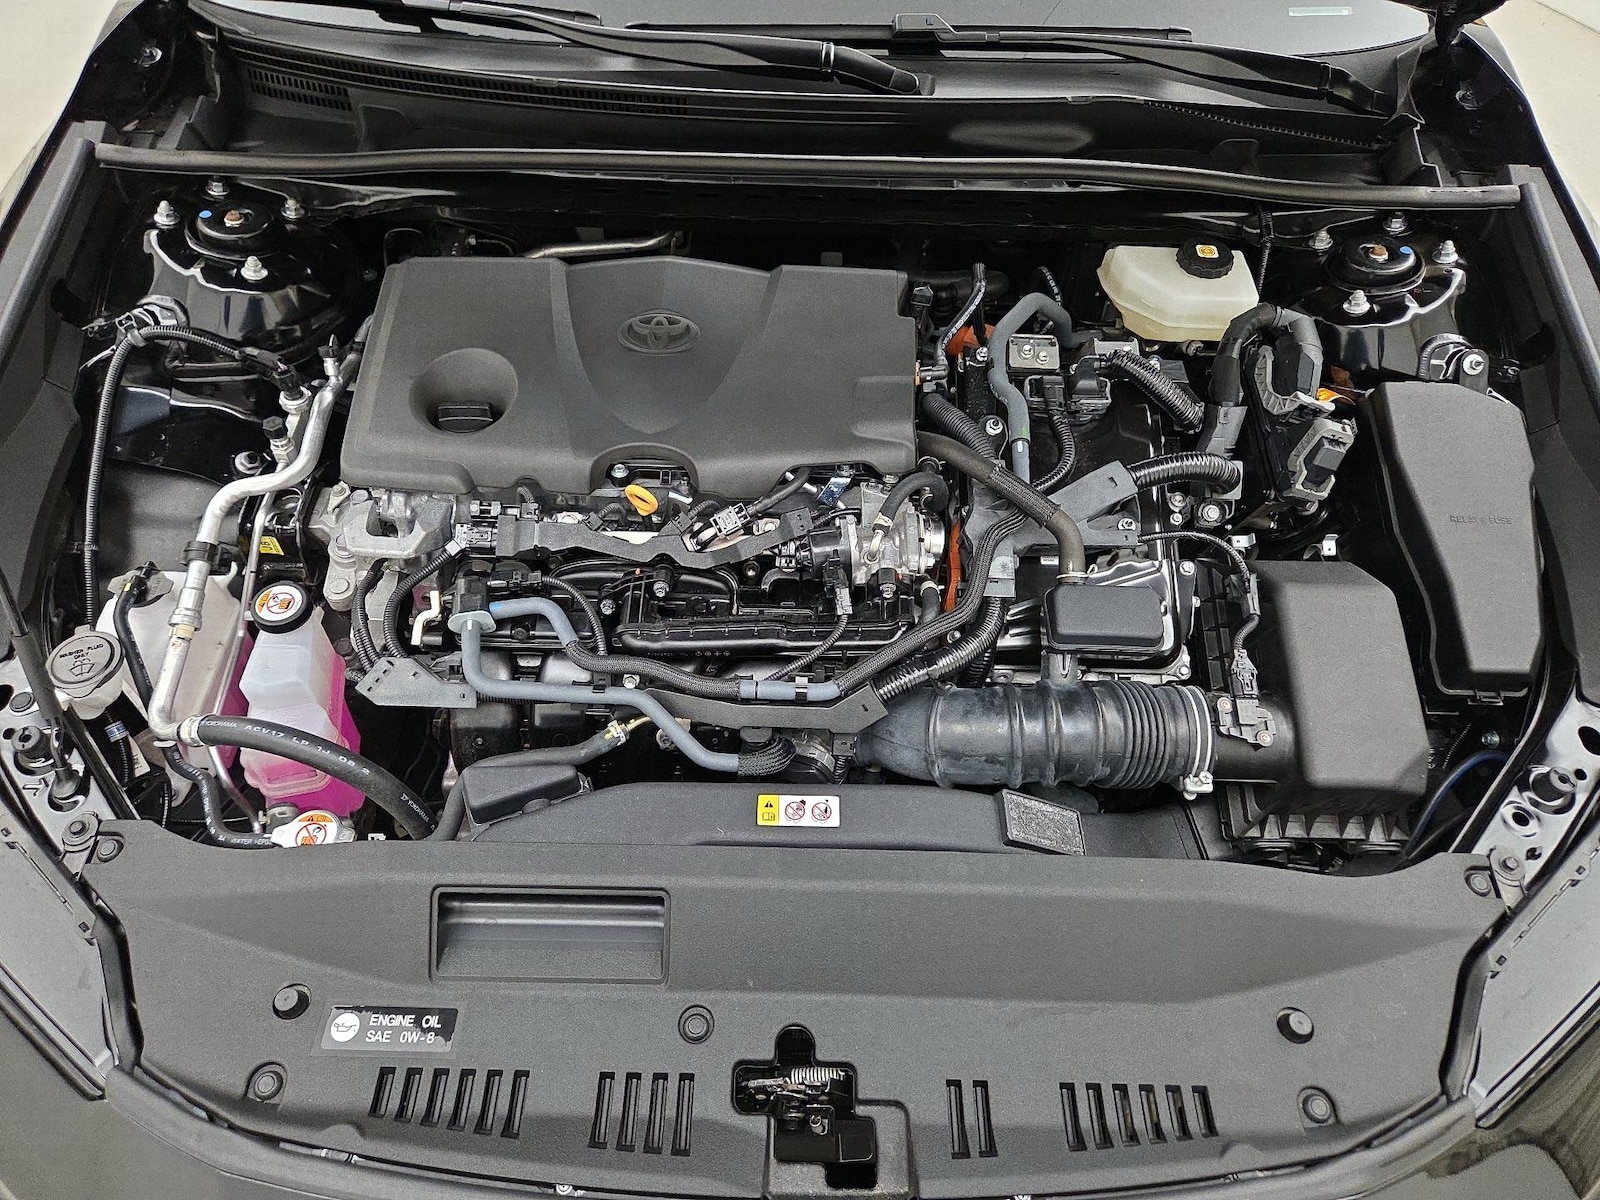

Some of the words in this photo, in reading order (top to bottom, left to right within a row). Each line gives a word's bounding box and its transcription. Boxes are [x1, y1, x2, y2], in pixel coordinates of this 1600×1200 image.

[1449, 515, 1478, 524] RELAY
[1488, 515, 1512, 525] FUSE
[244, 724, 285, 738] ACV17
[292, 736, 309, 746] LP
[369, 1014, 416, 1027] ENGINE
[422, 1014, 442, 1028] OIL
[365, 1029, 393, 1043] SAE
